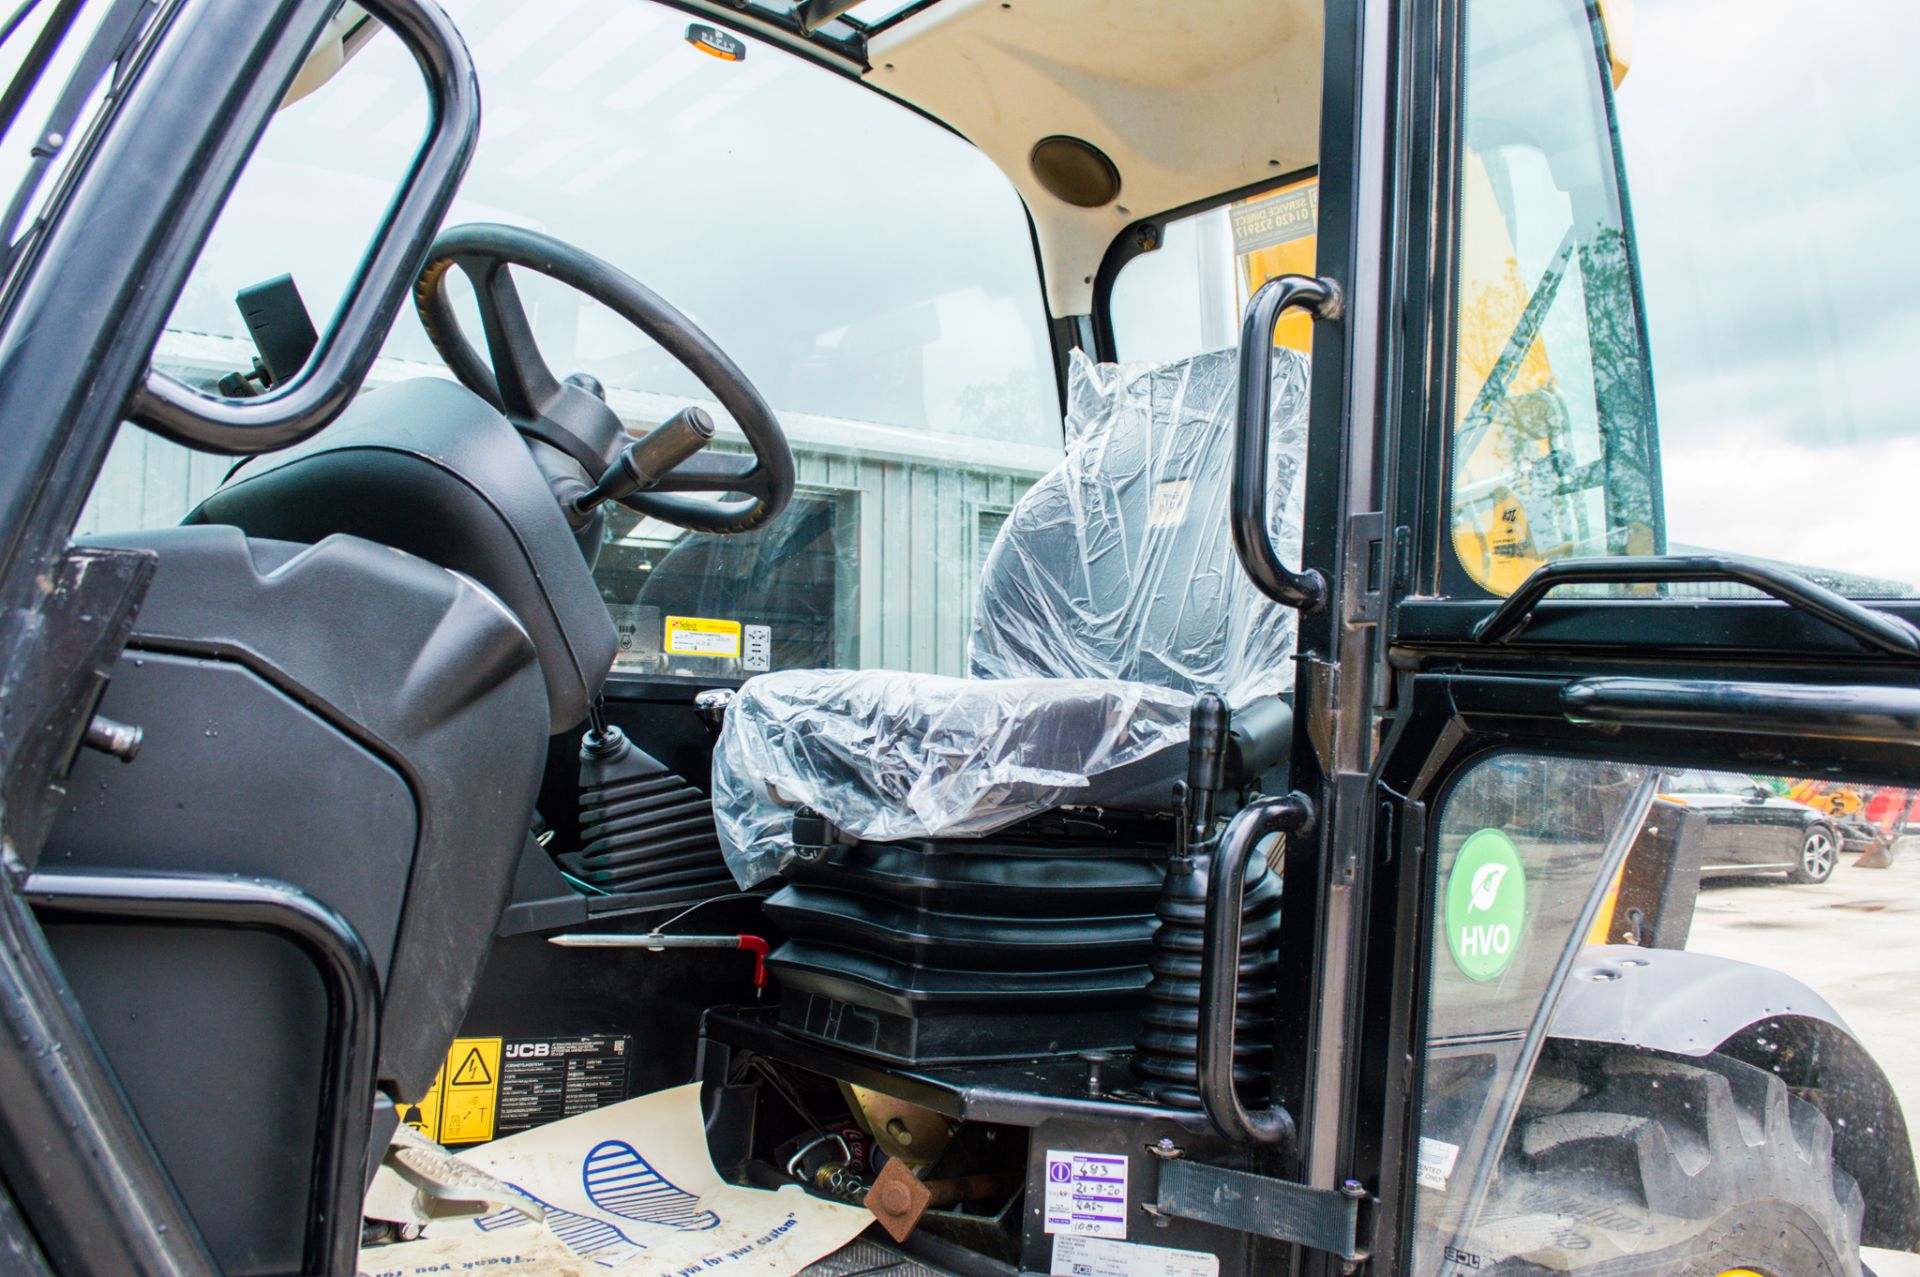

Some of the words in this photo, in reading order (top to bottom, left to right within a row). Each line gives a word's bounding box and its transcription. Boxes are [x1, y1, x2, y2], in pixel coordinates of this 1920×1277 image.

[1460, 923, 1511, 957] HVO
[505, 1042, 550, 1058] JCB
[702, 1256, 725, 1268] for
[726, 1244, 754, 1259] your
[415, 1262, 451, 1274] you
[1073, 1263, 1093, 1276] JCB
